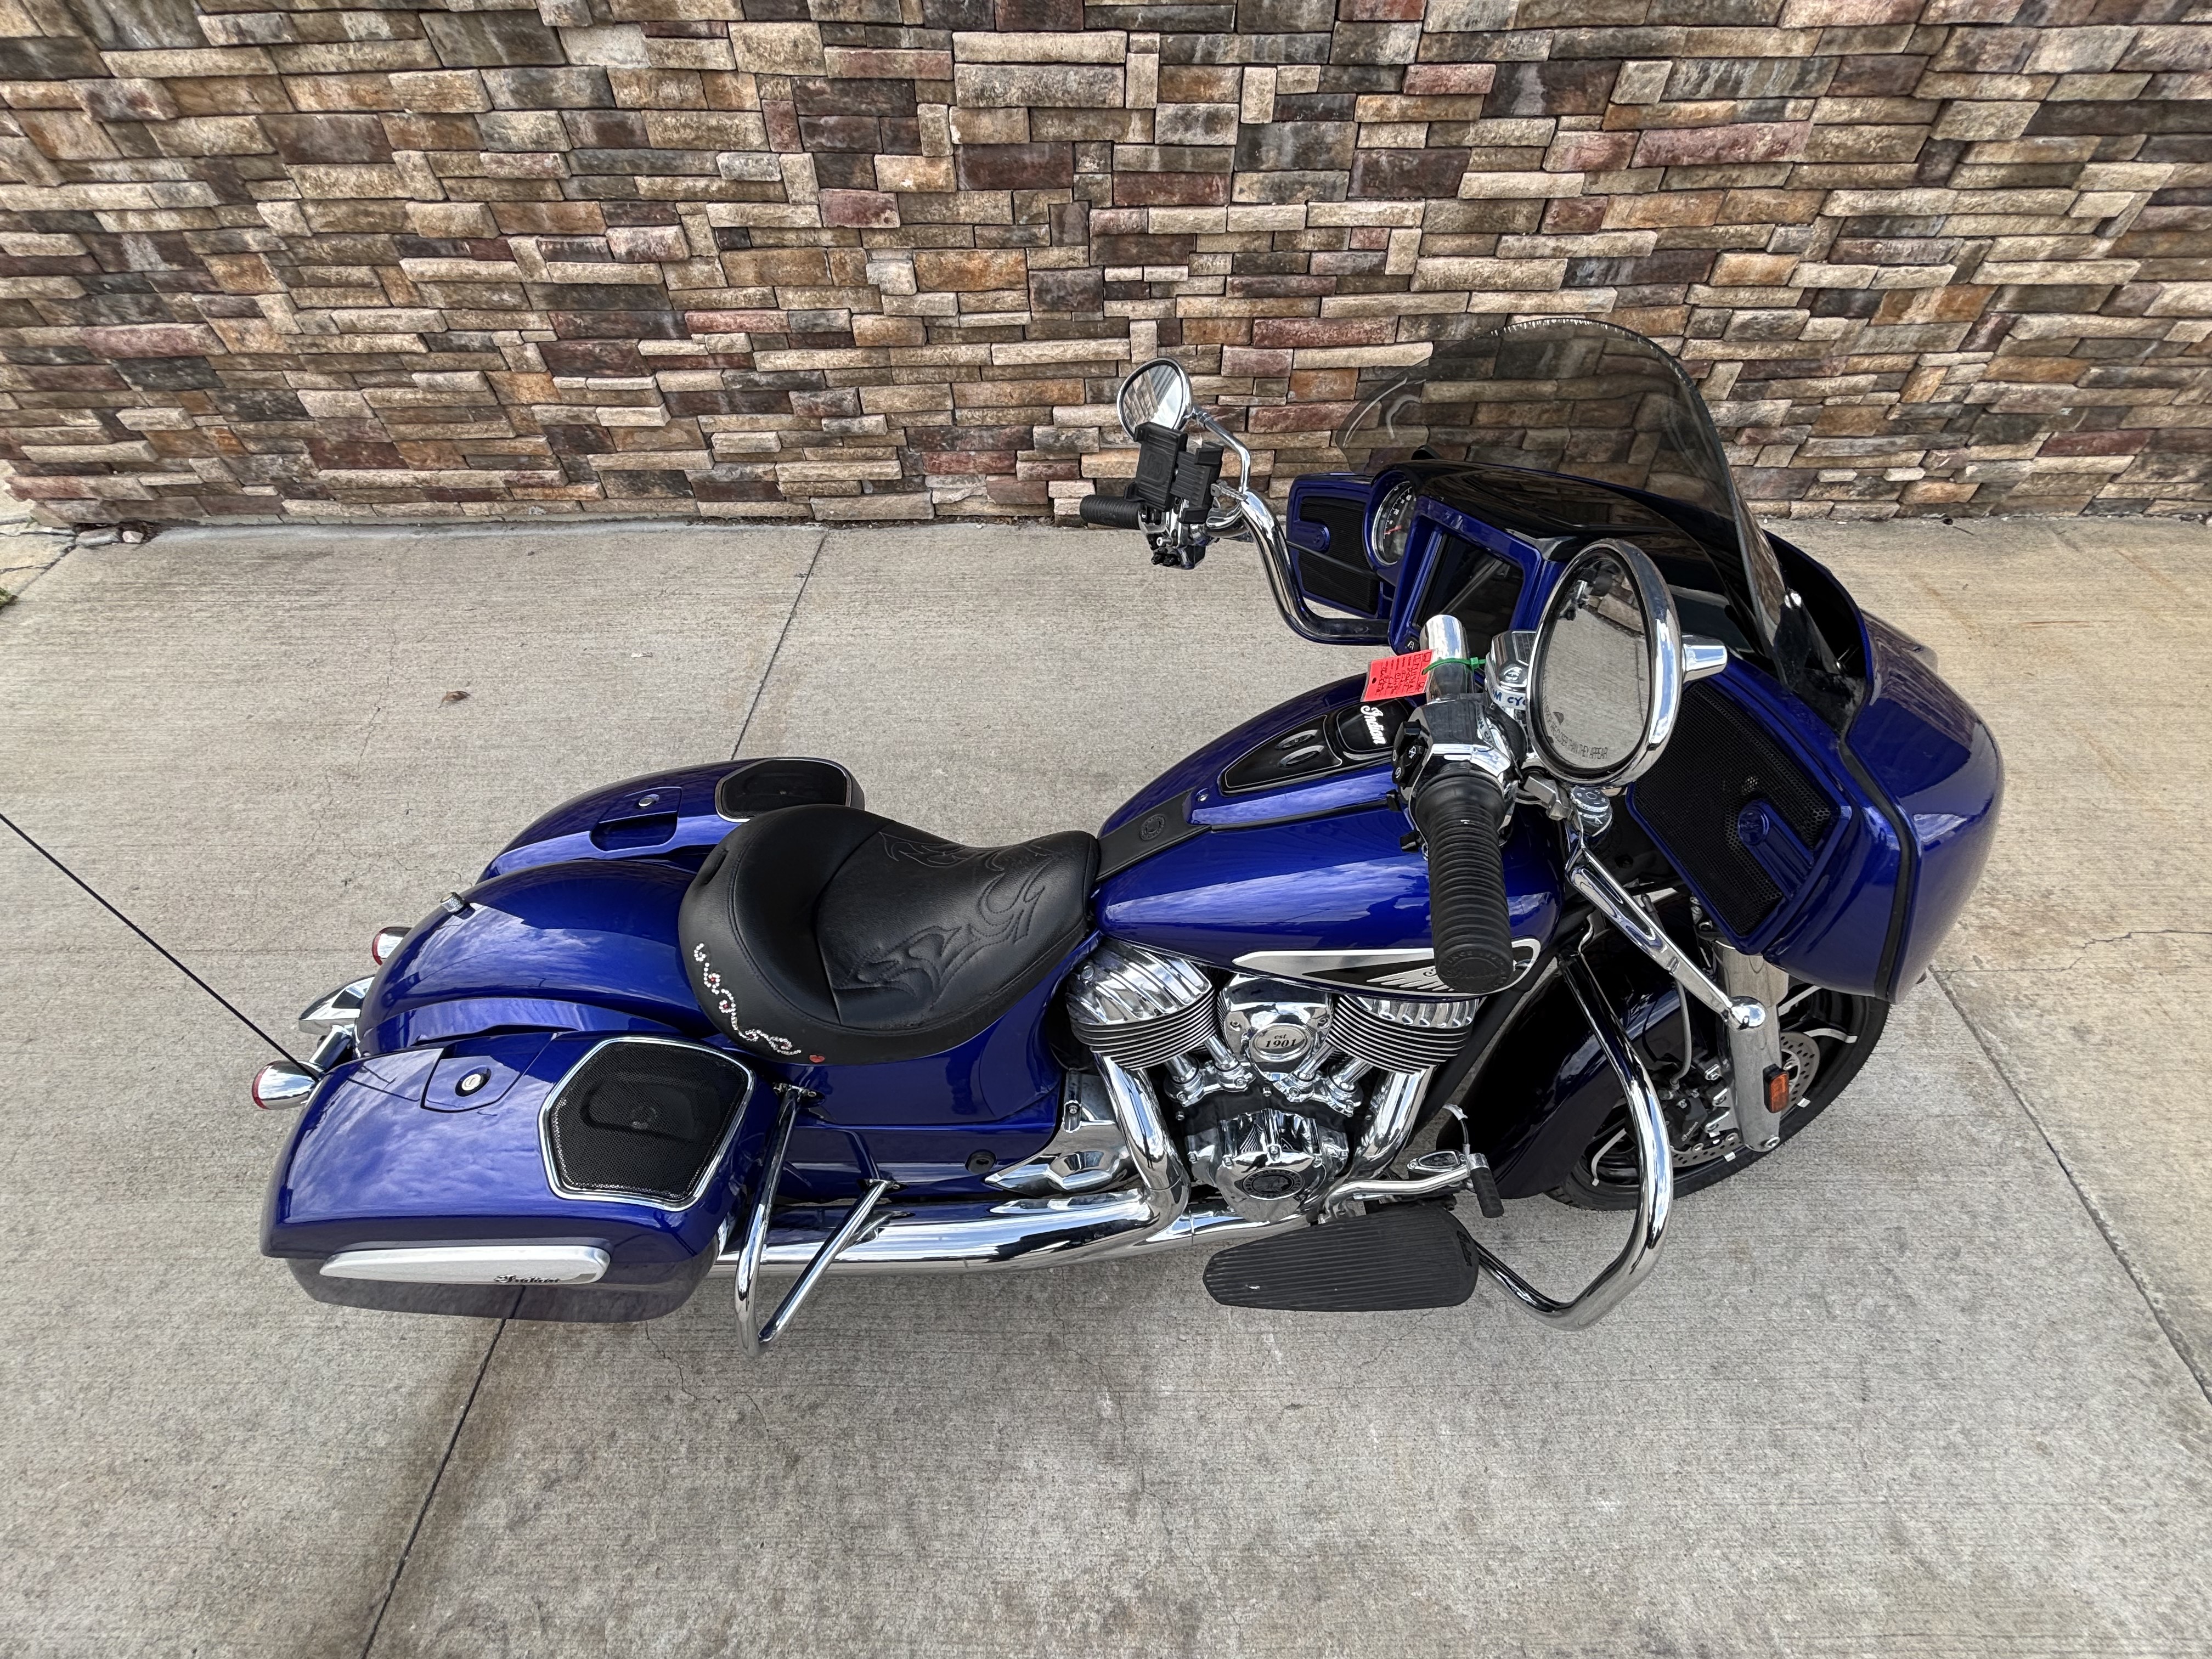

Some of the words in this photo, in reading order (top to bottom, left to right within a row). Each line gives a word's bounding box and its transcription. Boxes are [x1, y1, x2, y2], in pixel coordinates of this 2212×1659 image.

[1361, 705, 1386, 744] Indian
[1589, 747, 1608, 759] APPEAR
[1265, 1039, 1296, 1048] 1901
[494, 1273, 560, 1283] Indian
